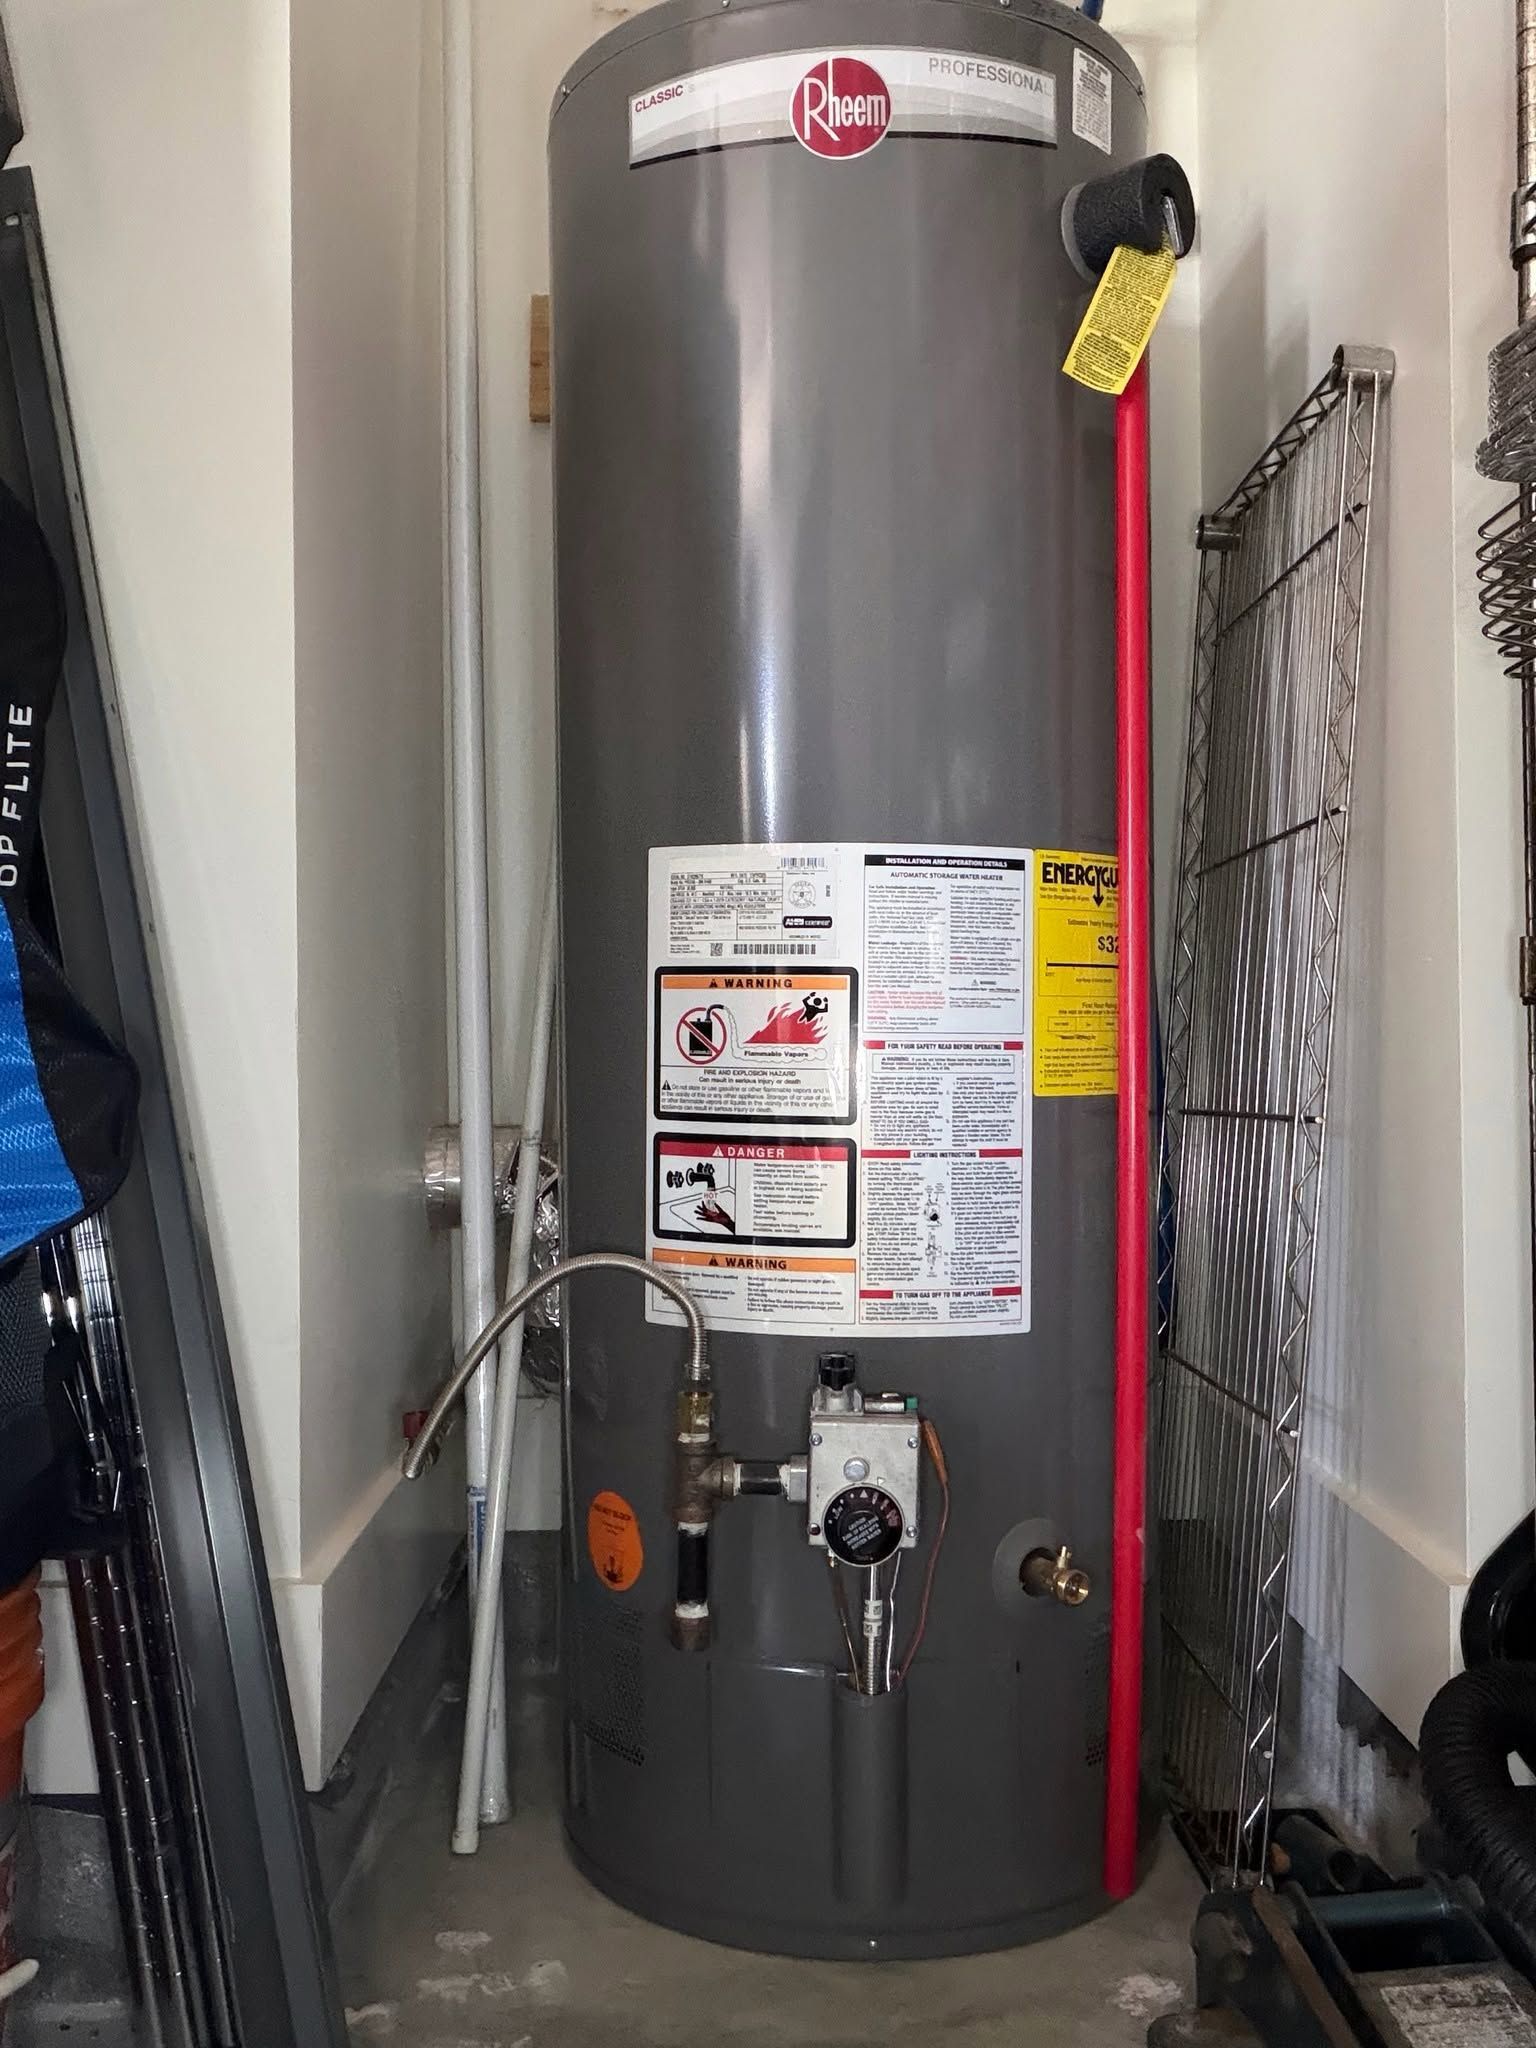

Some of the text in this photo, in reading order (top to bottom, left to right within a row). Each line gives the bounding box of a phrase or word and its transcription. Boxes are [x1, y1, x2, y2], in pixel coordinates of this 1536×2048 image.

[928, 57, 1054, 97] PROFESSIONAL
[634, 84, 684, 113] CLASSIC
[803, 56, 887, 142] Rheem
[1, 703, 33, 822] FLITE
[885, 857, 1007, 868] INSTALLATION AND OPERATION DETAILS
[724, 978, 793, 988] WARNING
[727, 1146, 785, 1159] DANGER
[725, 1256, 787, 1270] WARNING
